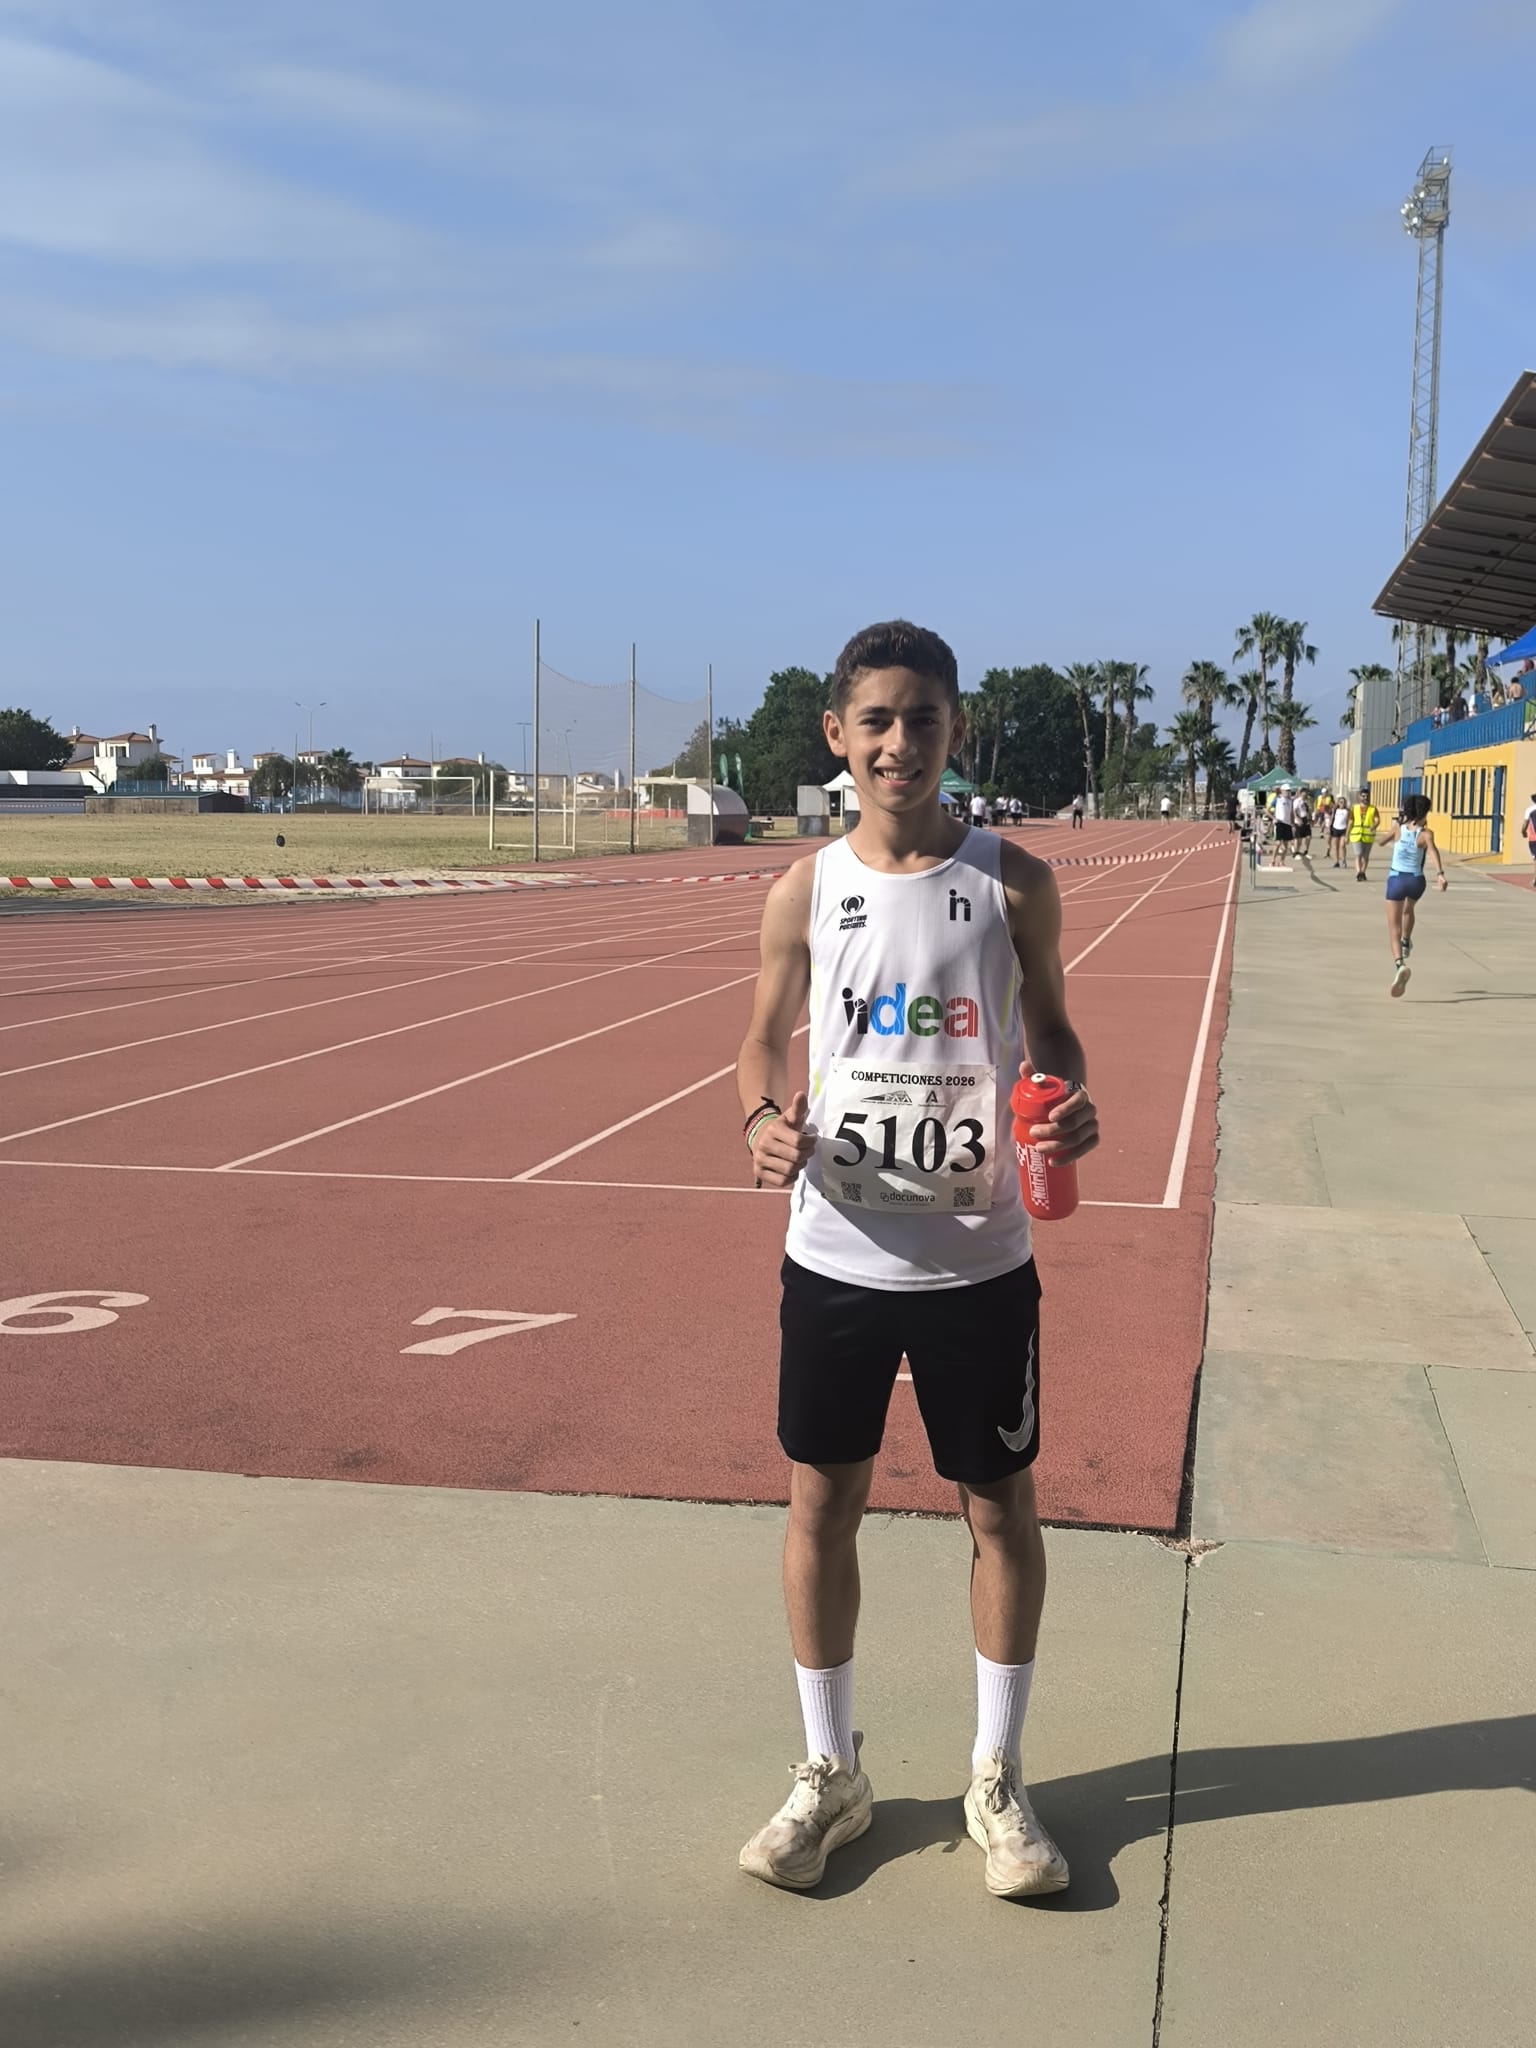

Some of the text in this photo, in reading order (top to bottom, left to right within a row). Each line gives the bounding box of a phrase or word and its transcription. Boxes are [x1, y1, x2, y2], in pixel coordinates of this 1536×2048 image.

[851, 1070, 976, 1087] COMPETICIONES 2026
[832, 1112, 987, 1173] 5103
[889, 1191, 936, 1202] docunova
[0, 1290, 150, 1335] 6
[400, 1307, 578, 1356] 7
